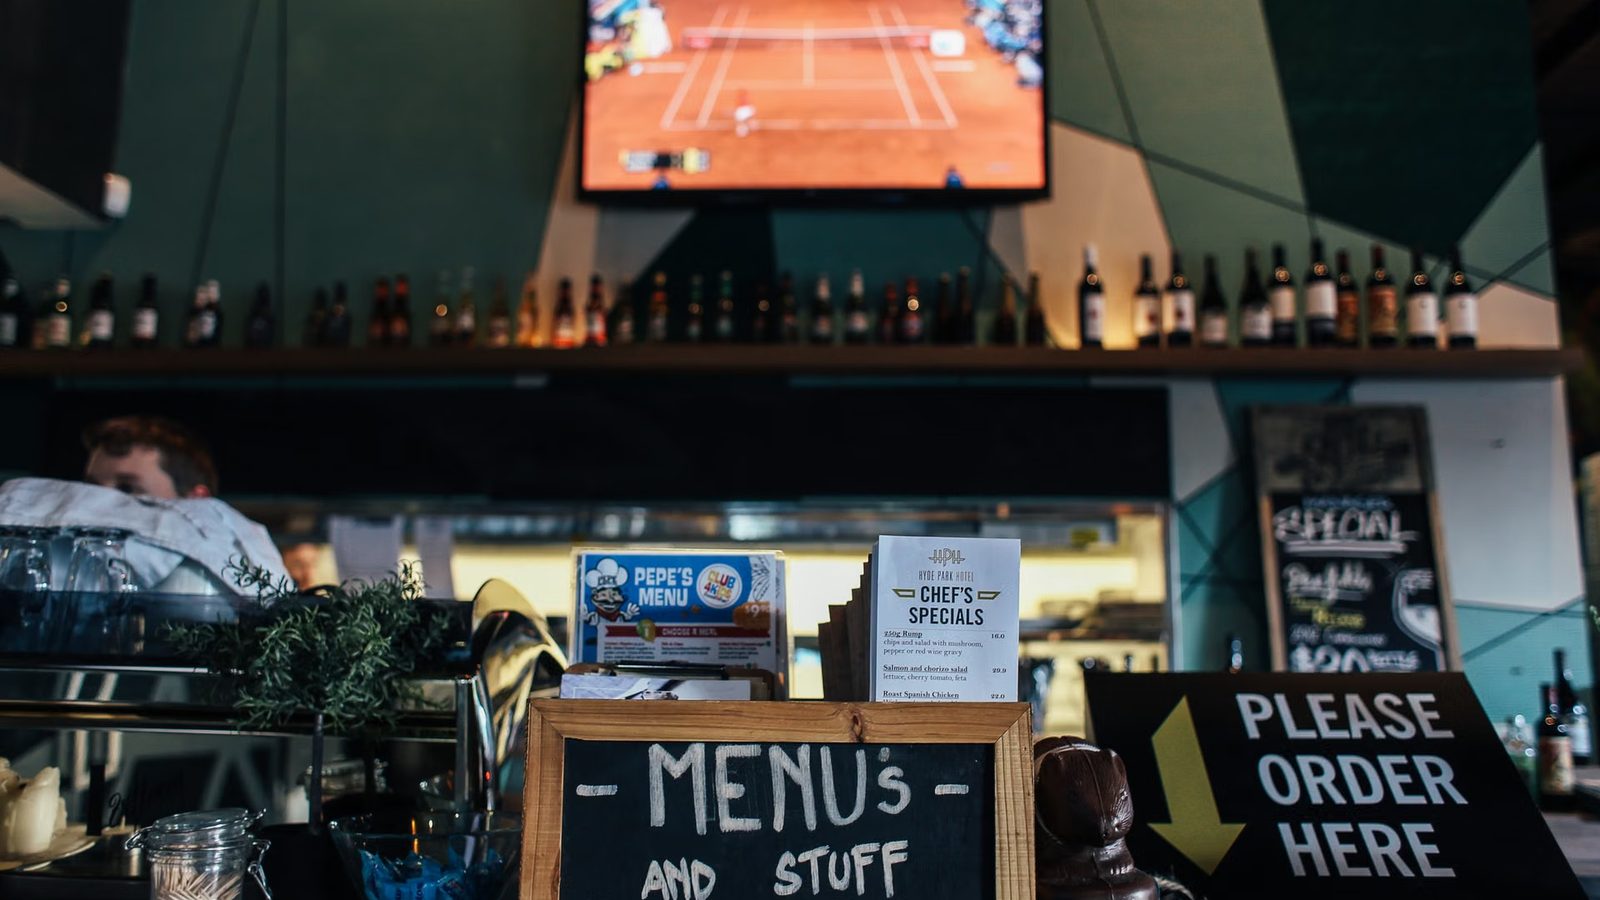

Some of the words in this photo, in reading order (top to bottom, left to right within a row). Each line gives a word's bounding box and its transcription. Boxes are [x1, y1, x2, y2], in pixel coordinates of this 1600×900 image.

[634, 567, 693, 586] PEPE'S
[708, 570, 736, 589] CLUB
[918, 570, 934, 581] HYDE
[937, 570, 953, 581] PARK
[955, 571, 974, 582] HOTEL
[638, 588, 688, 607] MENU
[920, 585, 973, 604] CHEF'S
[909, 607, 984, 625] SPECIALS
[902, 630, 923, 639] Rump
[883, 664, 909, 672] Salmon
[923, 665, 950, 673] chorizo
[883, 673, 907, 681] lettuce,
[907, 673, 929, 682] cherry
[930, 674, 954, 682] tomato,
[904, 691, 931, 699] Spanish
[931, 691, 959, 699] Chicken
[1236, 693, 1455, 740] PLEASE
[1257, 754, 1469, 806] ORDER
[1277, 823, 1456, 878] HERE
[641, 857, 716, 900] AND
[774, 840, 909, 899] STUFF
